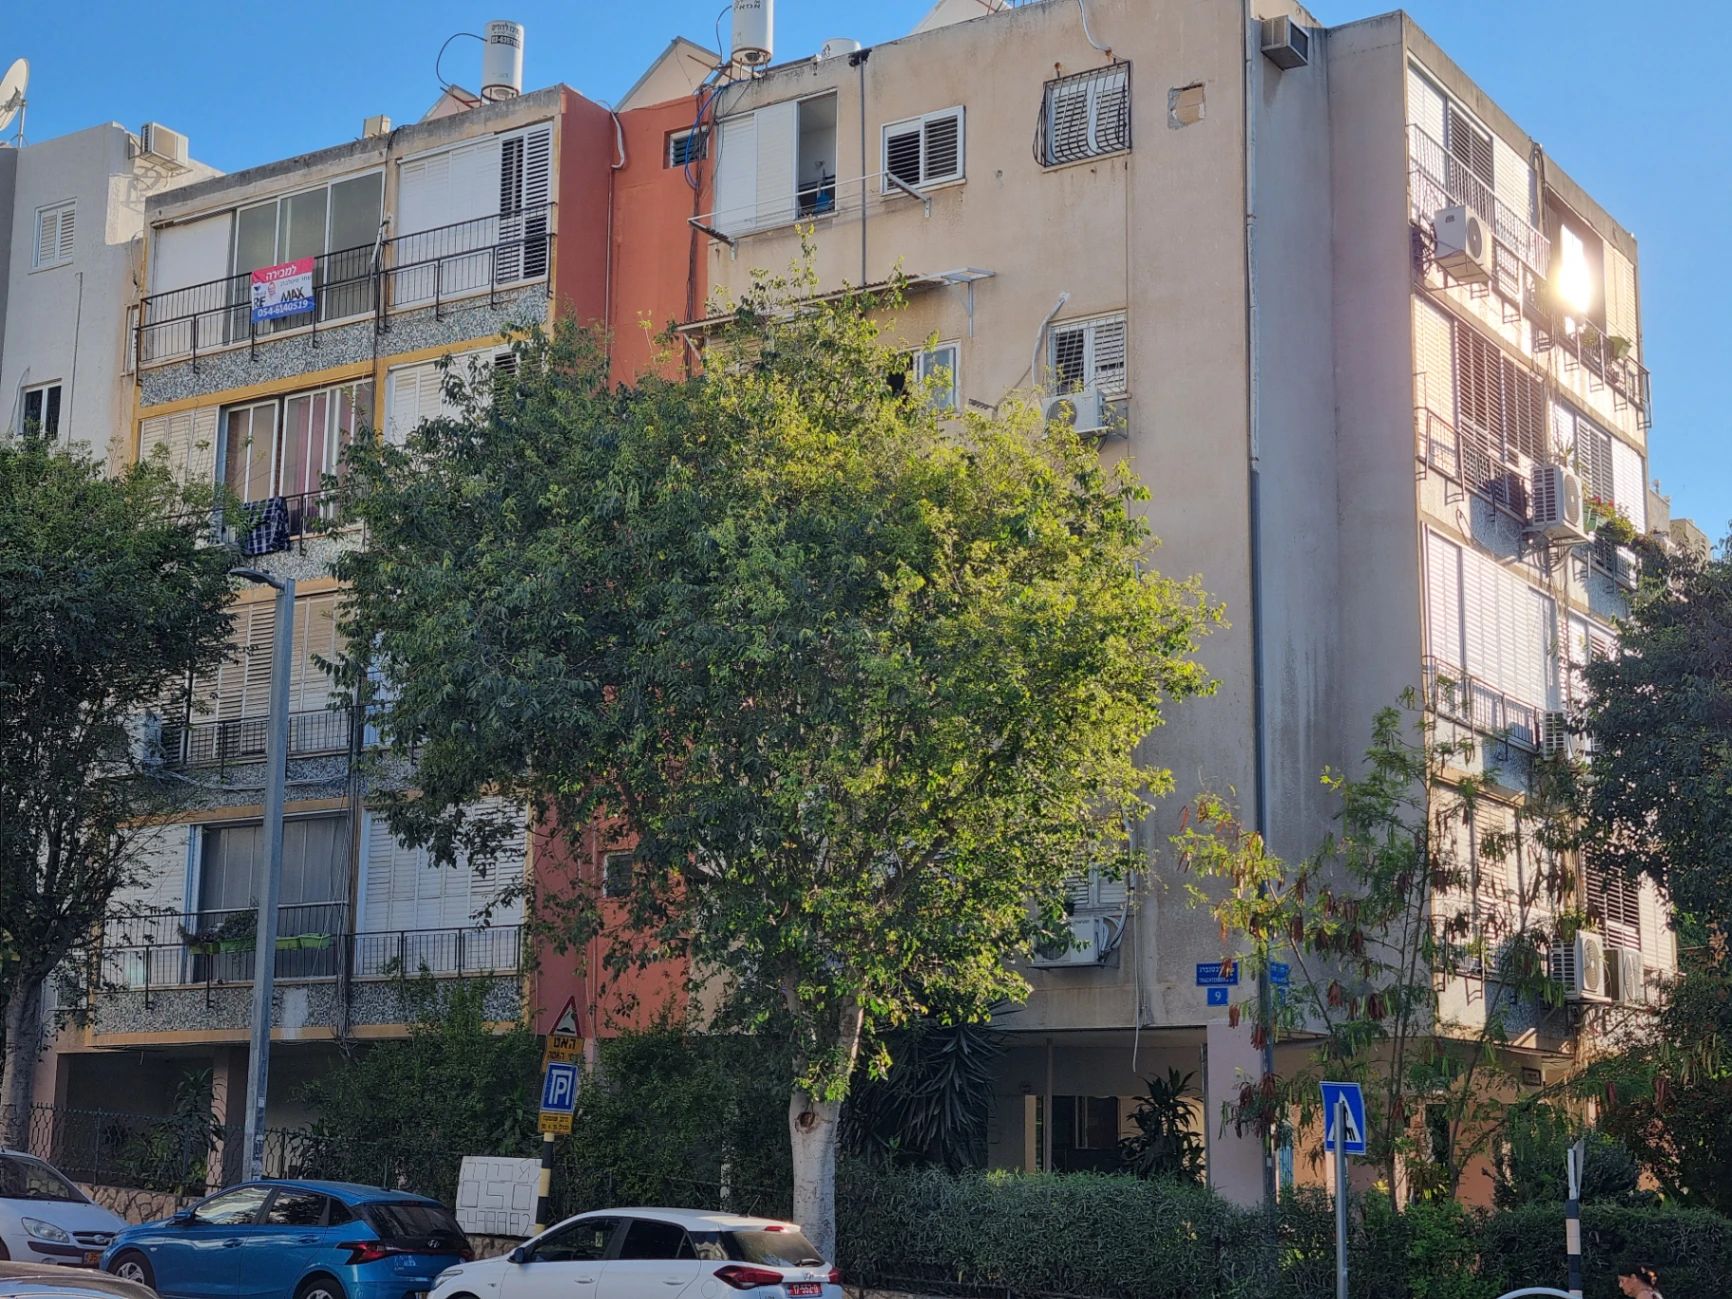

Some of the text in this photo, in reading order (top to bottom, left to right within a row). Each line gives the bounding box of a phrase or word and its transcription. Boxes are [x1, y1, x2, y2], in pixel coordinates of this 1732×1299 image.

[265, 265, 297, 281] למכירה
[253, 286, 305, 308] RE MAX
[1215, 991, 1222, 1001] 9
[553, 1037, 576, 1049] האט
[554, 1076, 568, 1105] P
[460, 1181, 532, 1211] 050
